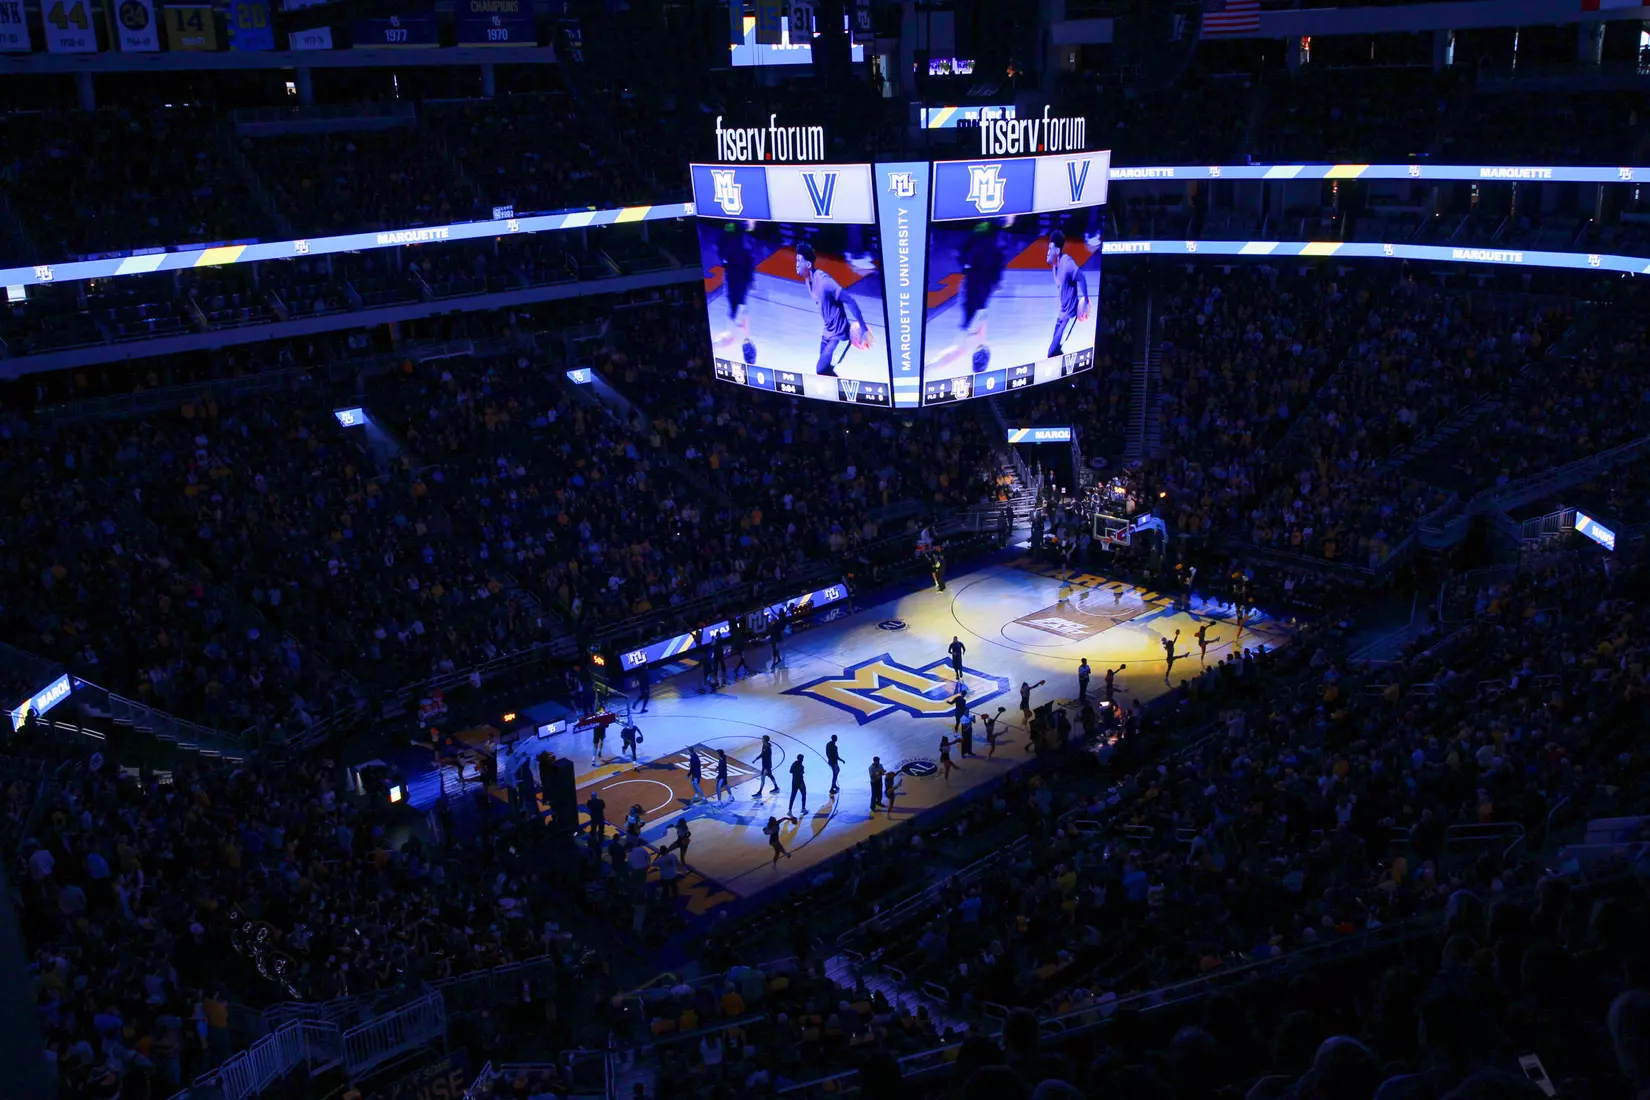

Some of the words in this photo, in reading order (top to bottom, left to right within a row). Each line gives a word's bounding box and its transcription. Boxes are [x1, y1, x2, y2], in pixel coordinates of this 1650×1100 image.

[48, 1, 89, 29] 44
[237, 3, 266, 29] 20
[470, 0, 519, 13] CHAMPIONS
[175, 8, 204, 32] 14
[384, 29, 407, 42] 1977
[486, 28, 508, 41] 1970
[1065, 160, 1091, 205] V
[1110, 168, 1174, 178] MARQUETTE
[1480, 167, 1552, 178] MARQUETTE
[710, 169, 743, 215] MU
[800, 171, 839, 218] V
[888, 172, 917, 199] MU
[966, 164, 1006, 213] MU
[377, 226, 448, 244] MARQUETTE
[898, 207, 910, 286] UNIVERSITY
[1452, 249, 1523, 262] MARQUETTE
[900, 292, 911, 371] MARQUETTE
[1064, 352, 1078, 376] V
[757, 372, 765, 385] 0
[986, 377, 995, 390] 0
[841, 380, 860, 402] V
[627, 649, 647, 665] MU
[778, 653, 1010, 726] MU
